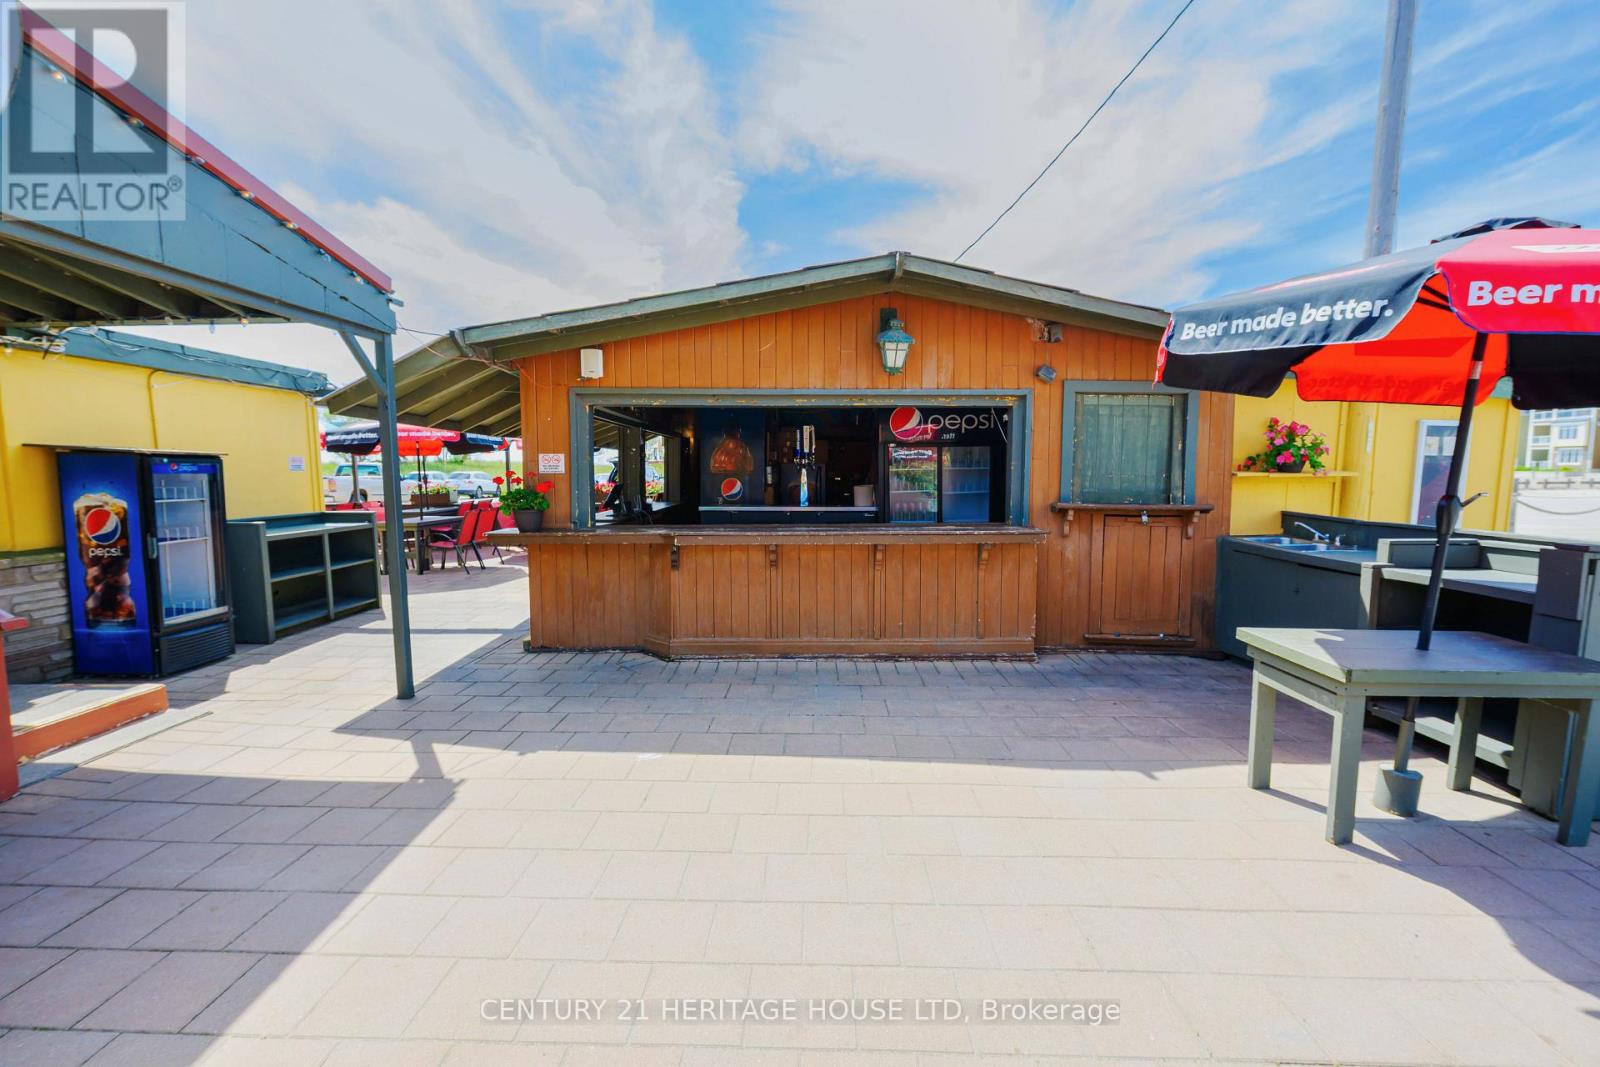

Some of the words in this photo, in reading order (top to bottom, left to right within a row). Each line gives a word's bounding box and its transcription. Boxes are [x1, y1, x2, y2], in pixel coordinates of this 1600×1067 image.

[1467, 280, 1563, 307] Beer
[1180, 320, 1229, 341] Beer
[1230, 307, 1297, 335] made
[1299, 298, 1394, 326] better.
[927, 409, 994, 434] pepsi
[88, 545, 121, 559] pepsi
